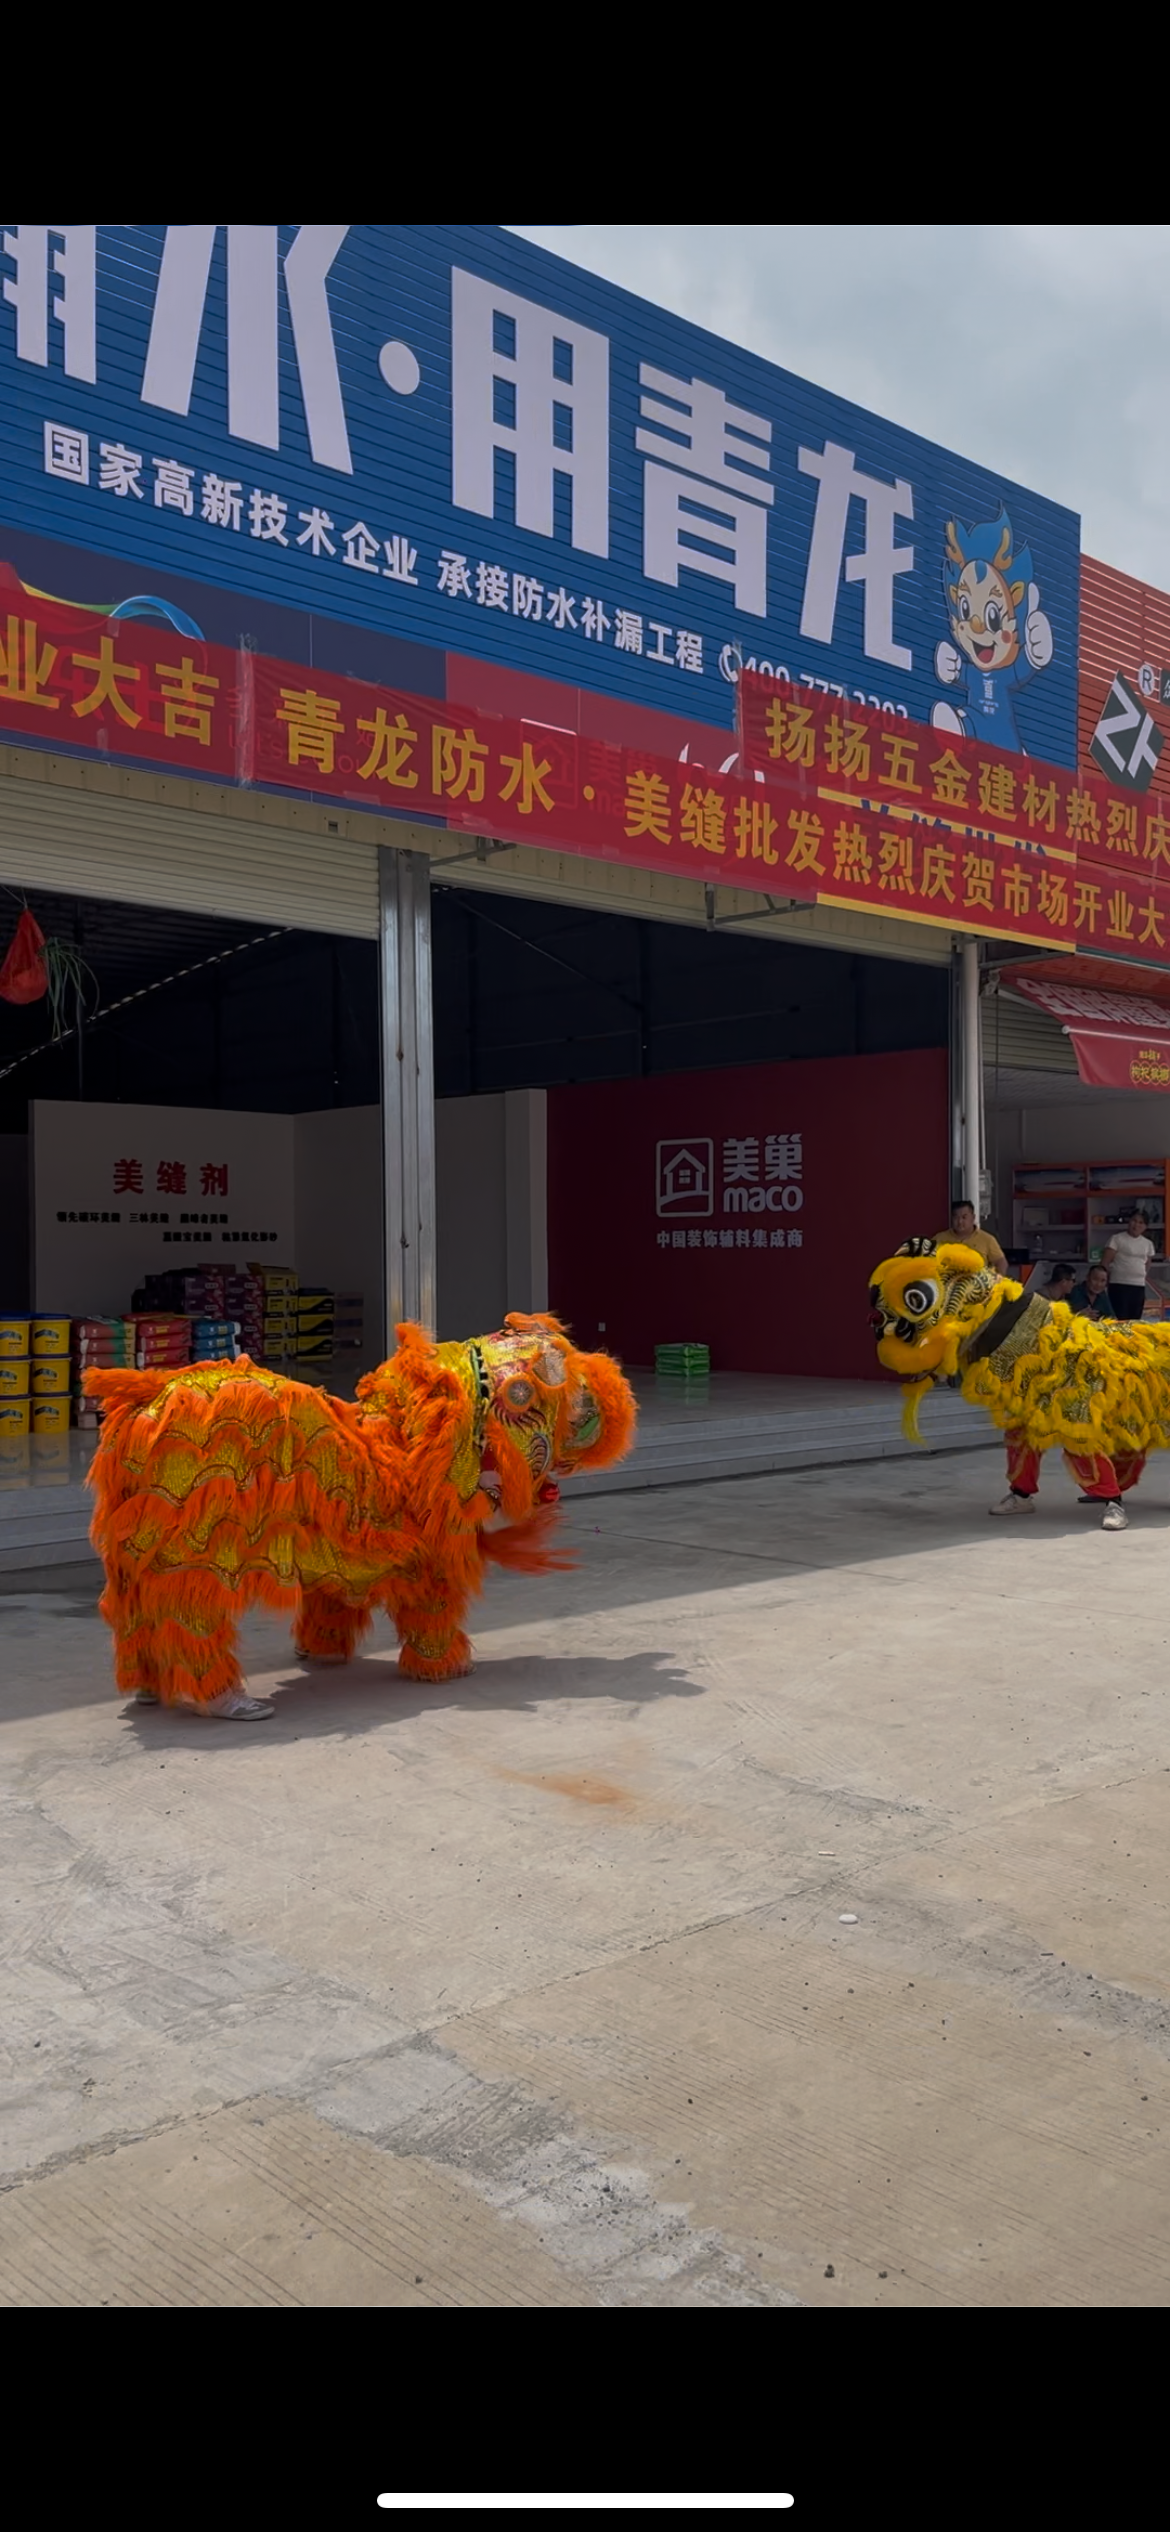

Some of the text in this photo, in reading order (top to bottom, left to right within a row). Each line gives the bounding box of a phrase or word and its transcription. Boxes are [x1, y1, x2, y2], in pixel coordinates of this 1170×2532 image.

[44, 421, 704, 675] 国家高新技术企业 承接防水补漏工程
[0, 614, 220, 747] 业大吉
[765, 697, 1170, 866] 扬扬五金建材热烈庆
[113, 1158, 230, 1197] 美缝剂
[723, 1133, 803, 1183] 美巢
[723, 1185, 804, 1213] maco
[656, 1228, 803, 1249] 中国装饰辅料集成商
